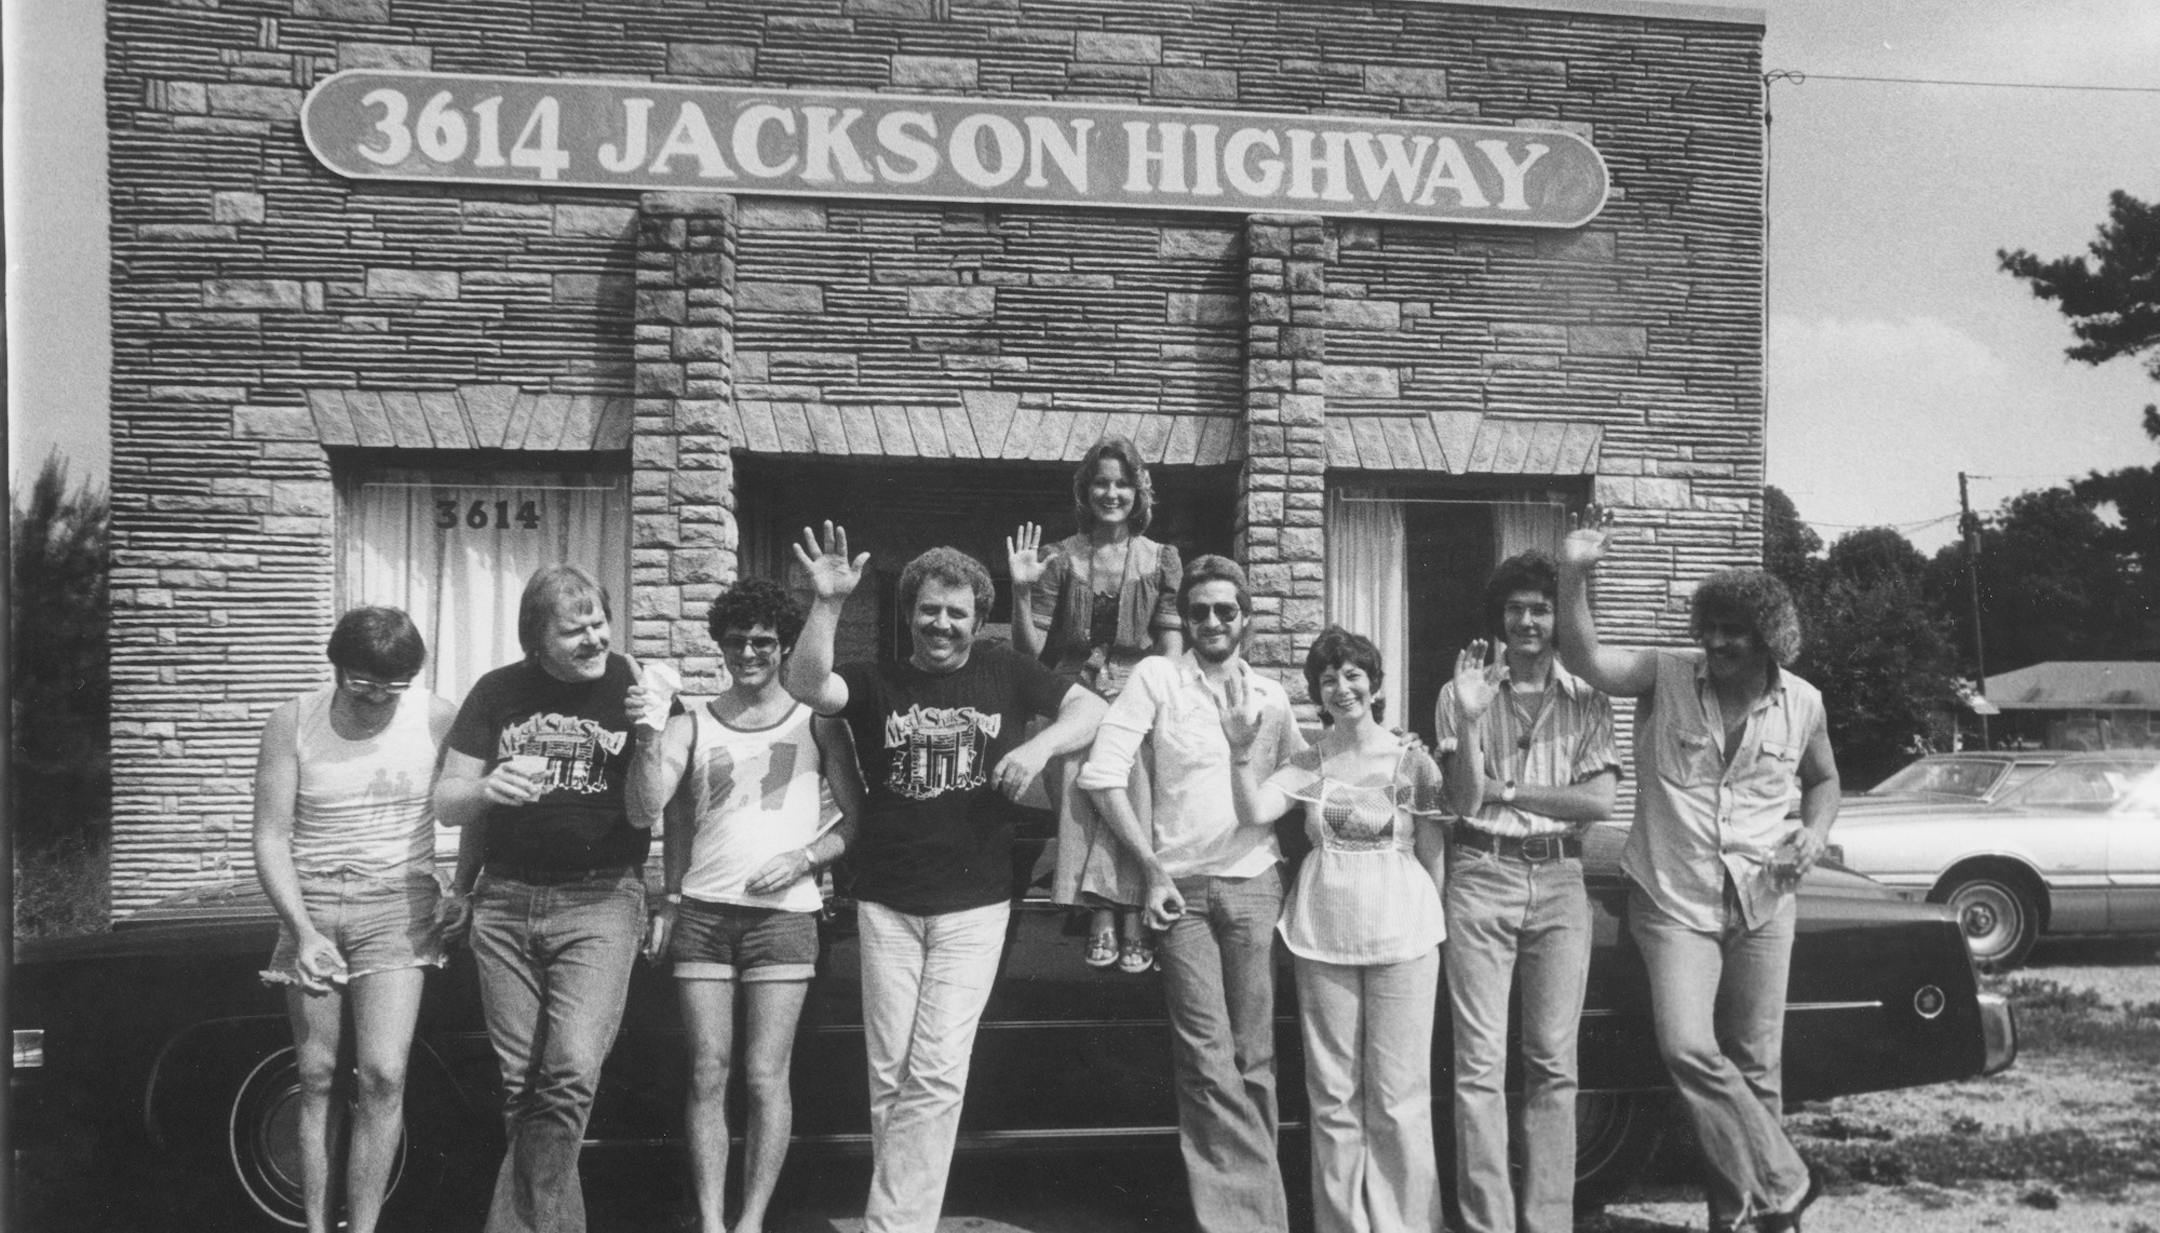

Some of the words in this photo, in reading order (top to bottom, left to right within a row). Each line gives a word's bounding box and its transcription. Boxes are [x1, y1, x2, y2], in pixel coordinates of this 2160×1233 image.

[357, 88, 570, 180] 3614
[598, 98, 1095, 195] JACKSON
[1122, 121, 1550, 211] HIGHWAY
[436, 500, 541, 530] 3614
